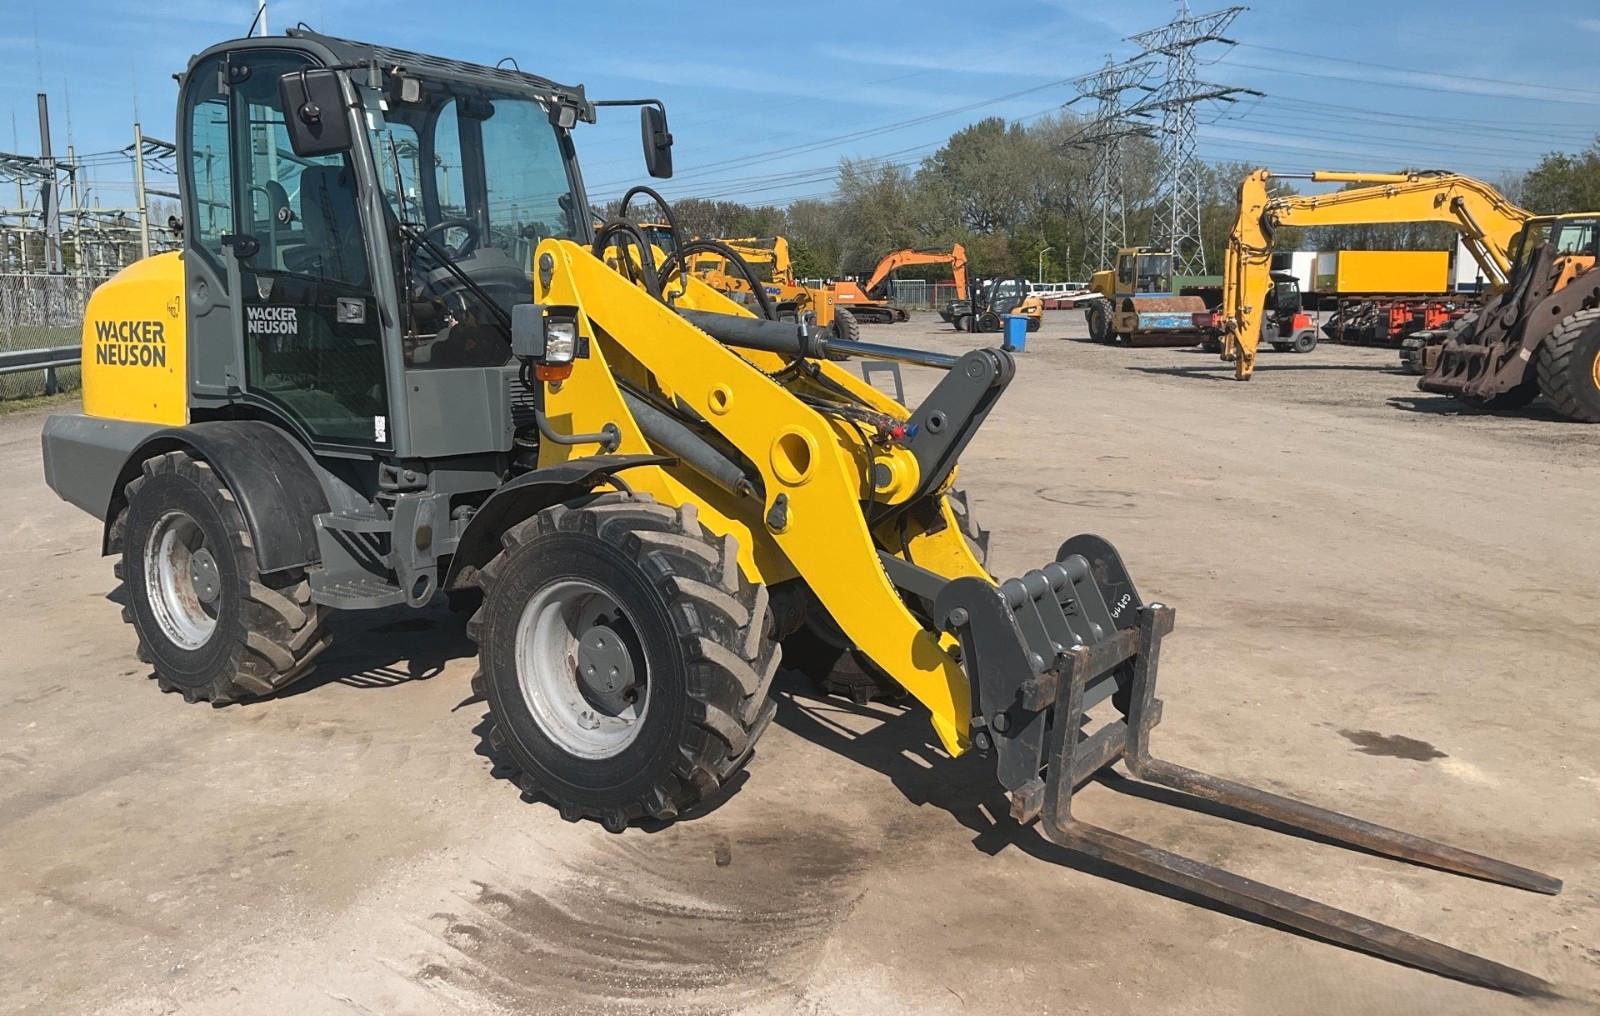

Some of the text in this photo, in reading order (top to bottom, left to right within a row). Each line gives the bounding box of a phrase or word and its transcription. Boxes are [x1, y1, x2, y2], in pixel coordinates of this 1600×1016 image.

[246, 306, 297, 321] WACKER
[95, 320, 166, 343] WACKER
[248, 320, 298, 335] NEUSON
[96, 343, 166, 368] NEUSON
